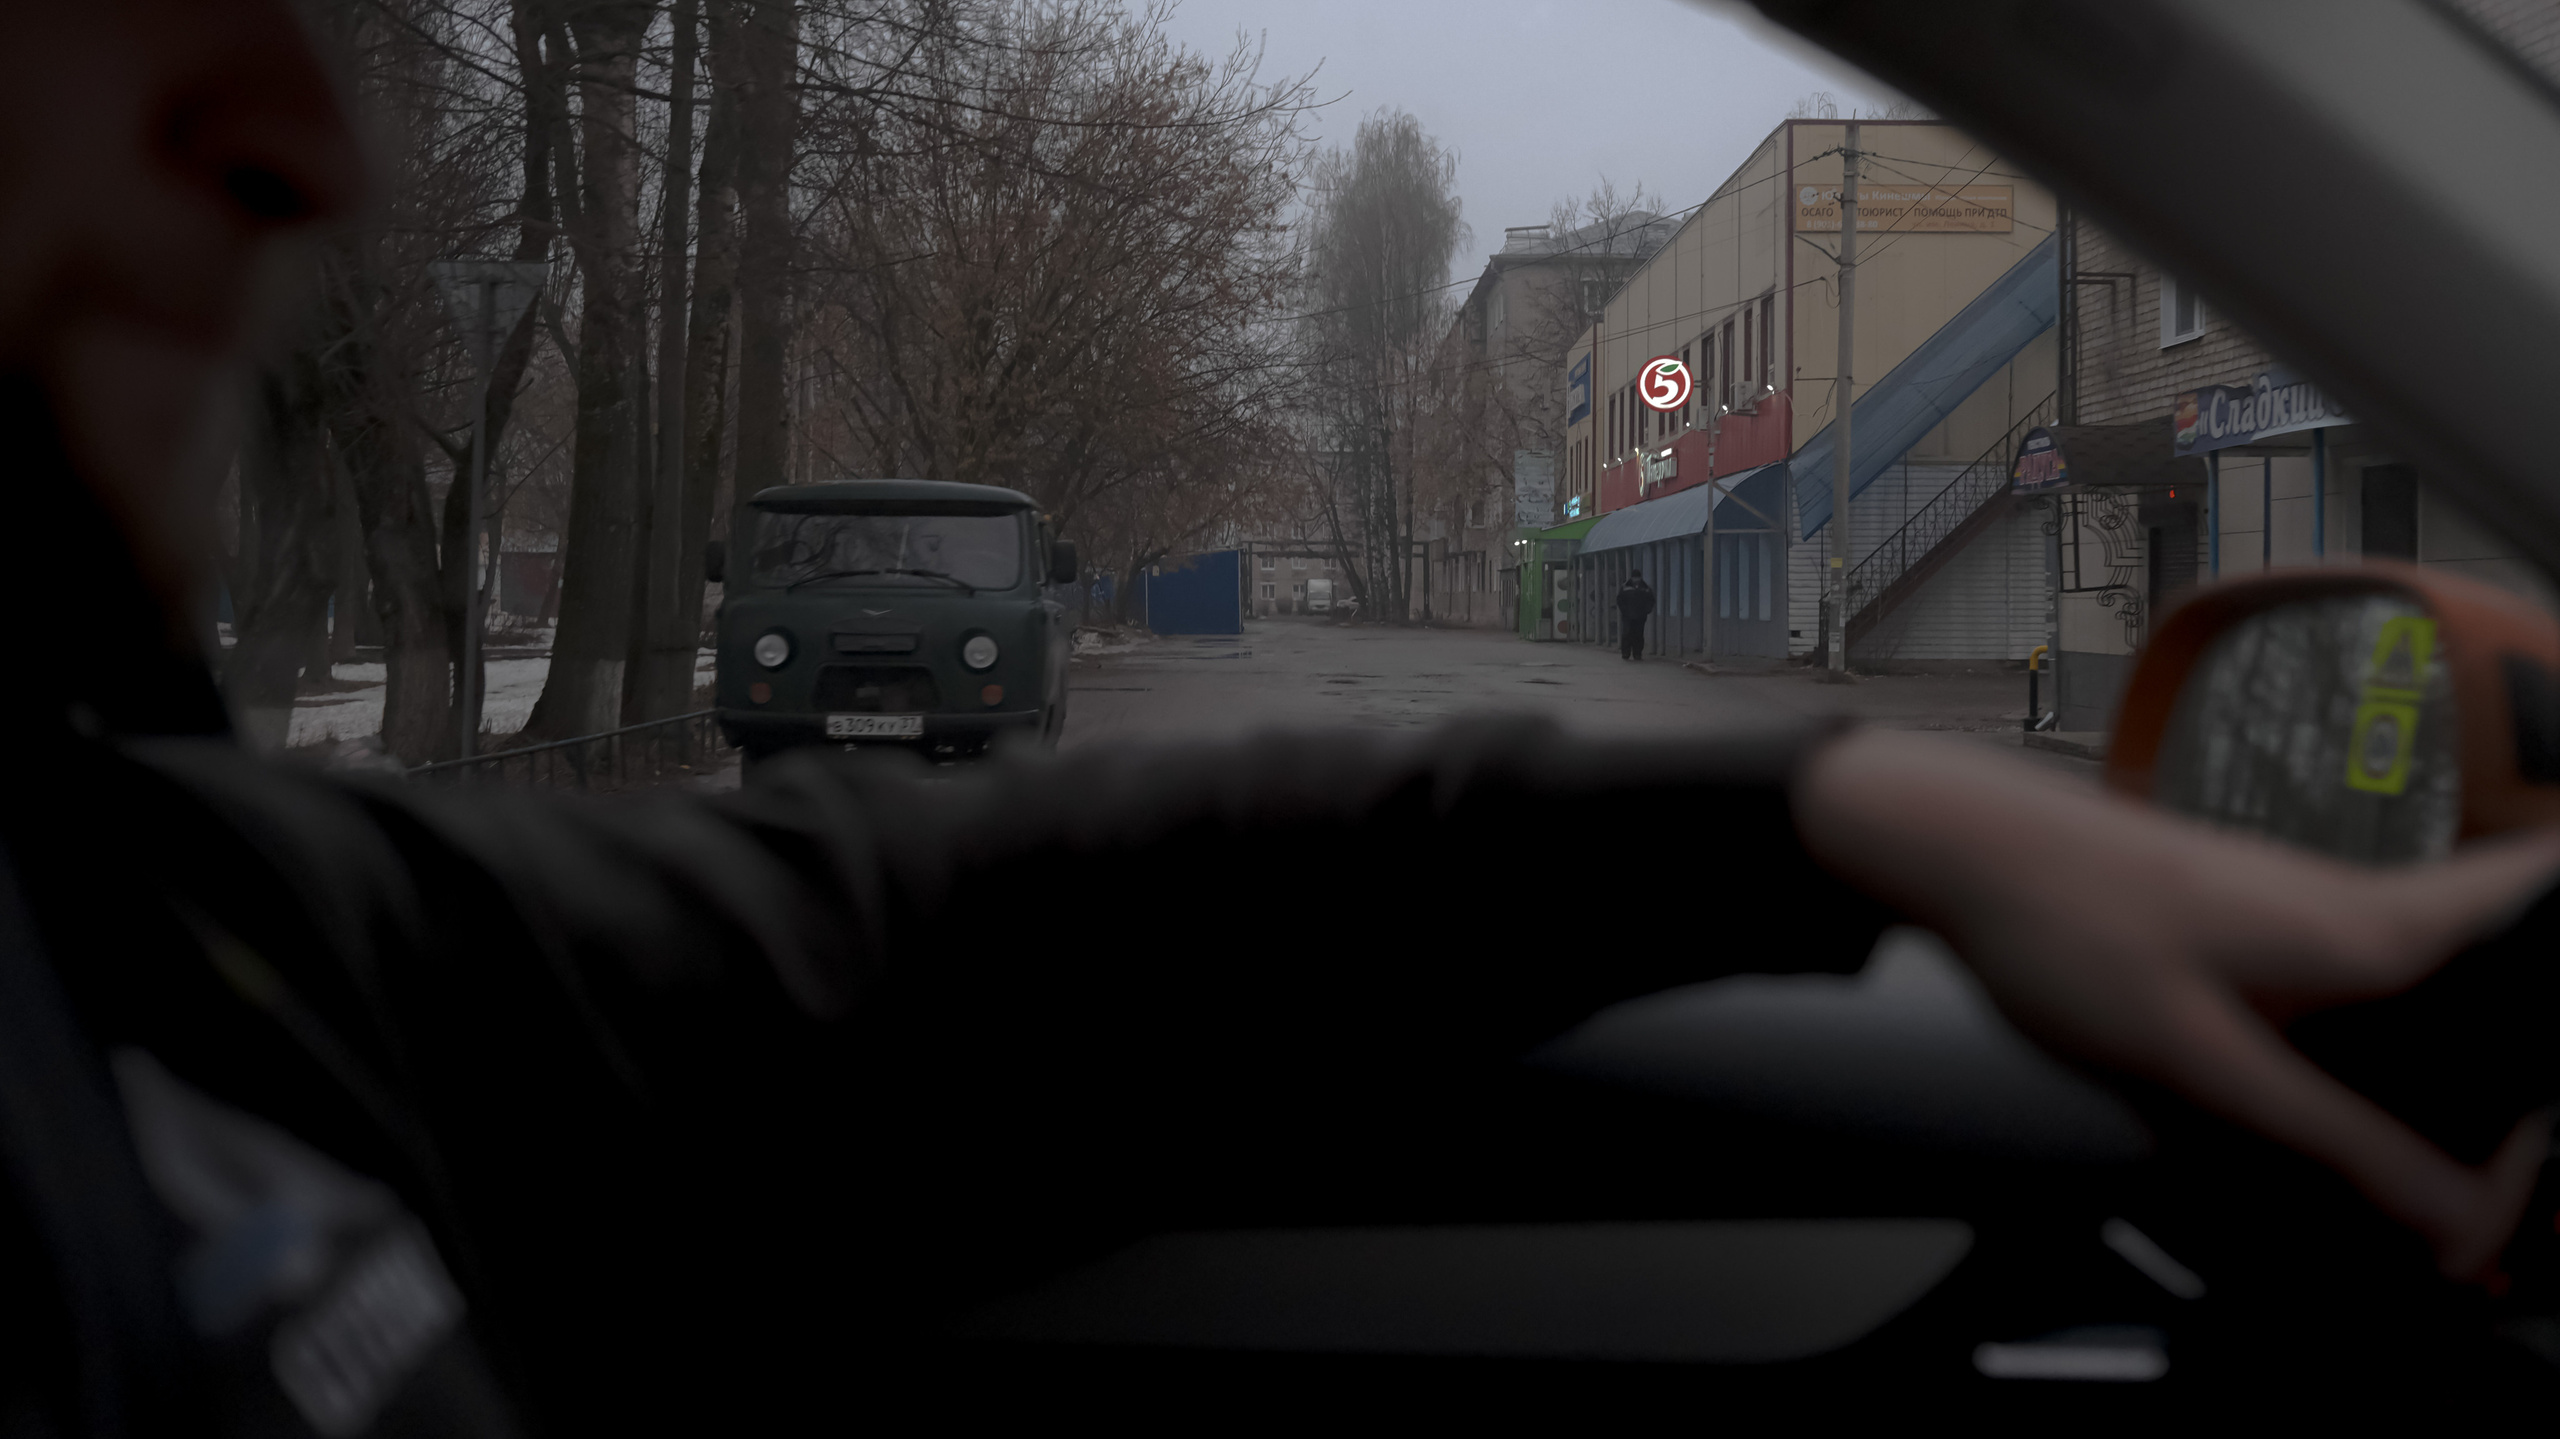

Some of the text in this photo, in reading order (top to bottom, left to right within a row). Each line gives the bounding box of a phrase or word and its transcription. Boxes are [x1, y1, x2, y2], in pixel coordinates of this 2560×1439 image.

[1801, 207, 1834, 217] ОСАГО
[1857, 207, 1904, 217] ТОЮРИСТ
[1914, 207, 2007, 219] ПОМОЩЬ ПРИ ДТП
